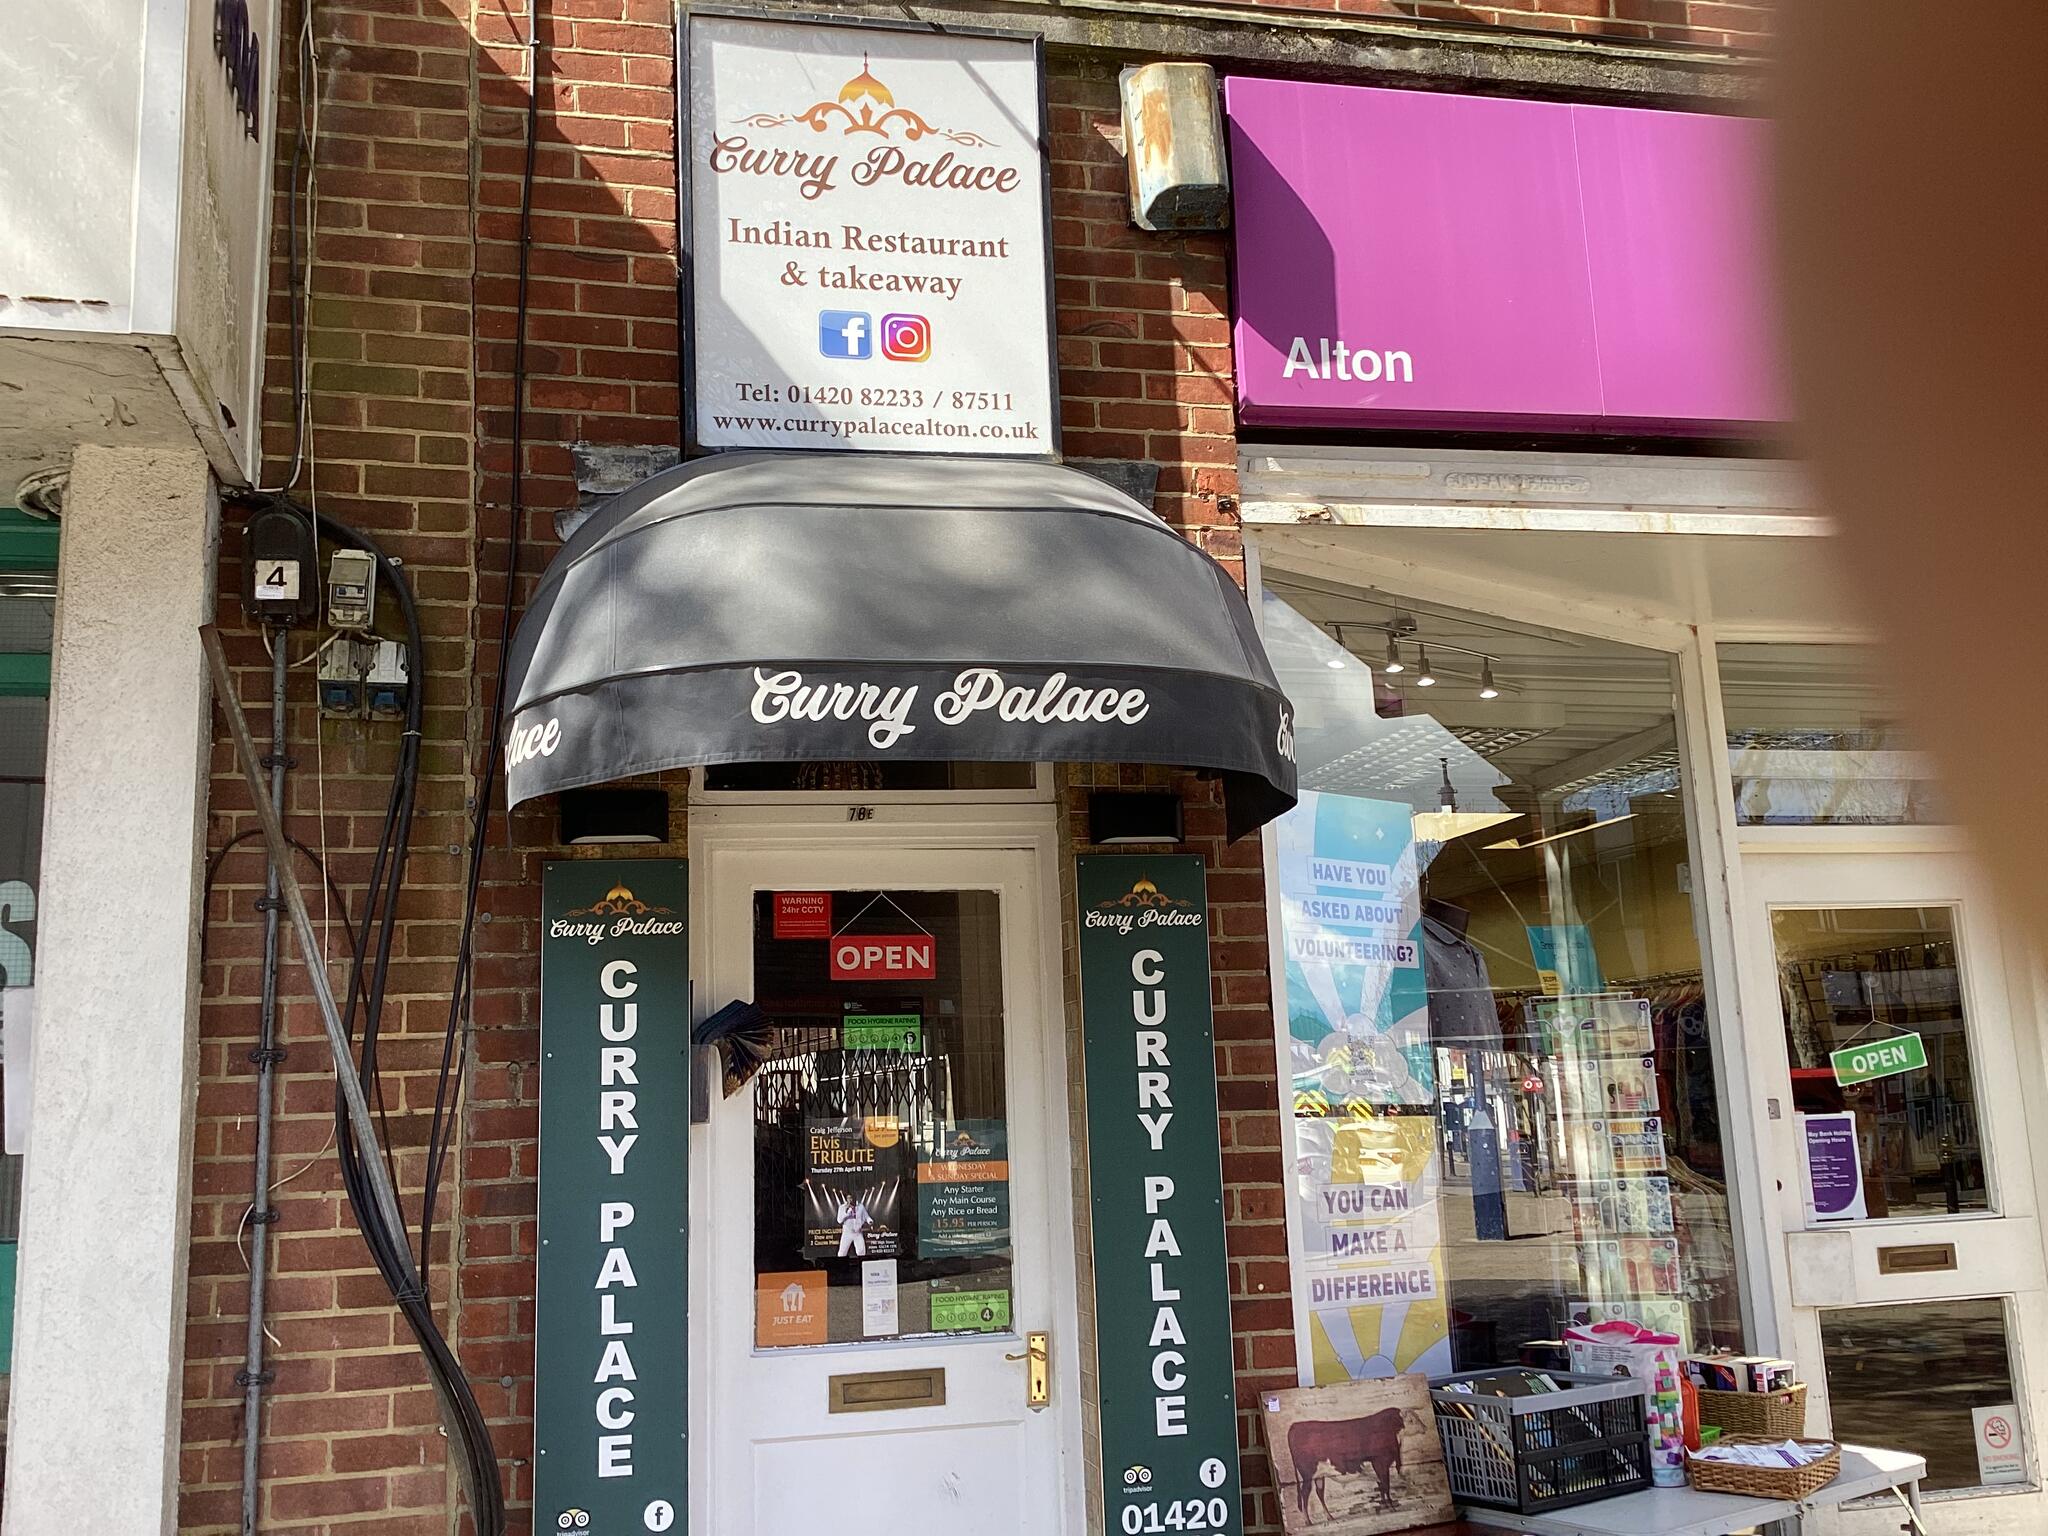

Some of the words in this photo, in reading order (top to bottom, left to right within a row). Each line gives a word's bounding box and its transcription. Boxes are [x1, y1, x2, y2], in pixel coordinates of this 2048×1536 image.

[709, 131, 838, 200] Curry
[851, 146, 1021, 194] Palace
[728, 218, 831, 250] Indian
[842, 226, 1009, 258] Restaurant
[780, 262, 808, 286] &
[818, 265, 963, 300] takeaway
[1282, 336, 1413, 383] Alton
[735, 383, 780, 403] Tel:
[788, 385, 852, 407] 01420
[860, 387, 923, 408] 82233
[933, 391, 943, 409] /
[952, 391, 1013, 411] 87511
[713, 415, 1039, 440] www.currypalacealton.co.uk
[266, 566, 288, 587] 4
[750, 666, 918, 749] Curry
[934, 667, 1149, 726] Palace
[1313, 862, 1353, 883] HAVE
[1356, 866, 1386, 886] YOU
[782, 897, 824, 905] WARNING
[782, 906, 800, 914] 24hr
[801, 906, 824, 914] CCTV
[1301, 900, 1350, 920] ASKED
[1354, 904, 1403, 924] ABOUT
[550, 918, 607, 945] Curry
[610, 917, 684, 937] Palace
[1085, 910, 1133, 935] Curry
[1138, 909, 1202, 928] Palace
[836, 945, 930, 970] OPEN
[1294, 938, 1414, 963] VOLUNTEERING?
[1131, 949, 1174, 1151] CURRY
[1852, 1045, 1908, 1073] OPEN
[596, 960, 640, 1175] CURRY
[811, 1136, 840, 1150] Elvis
[960, 1146, 991, 1156] Palace
[810, 1149, 875, 1165] TRIBUTE
[932, 1197, 948, 1206] Any
[949, 1196, 969, 1204] Main
[970, 1195, 996, 1204] Course
[944, 1186, 959, 1195] Any
[961, 1185, 985, 1193] Starter
[1323, 1190, 1365, 1215] YOU
[1370, 1187, 1409, 1212] CAN
[931, 1208, 947, 1217] Any
[948, 1207, 965, 1215] Rice
[976, 1206, 998, 1214] Bread
[1331, 1230, 1388, 1258] MAKE
[1394, 1229, 1408, 1253] A
[1311, 1269, 1432, 1303] DIFFERENCE
[1144, 1176, 1188, 1437] PALACE
[772, 1315, 795, 1326] JUST
[796, 1314, 814, 1324] EAT
[593, 1201, 638, 1478] PALACE
[1123, 1486, 1153, 1494] tripadvisor
[1121, 1498, 1228, 1535] 01420
